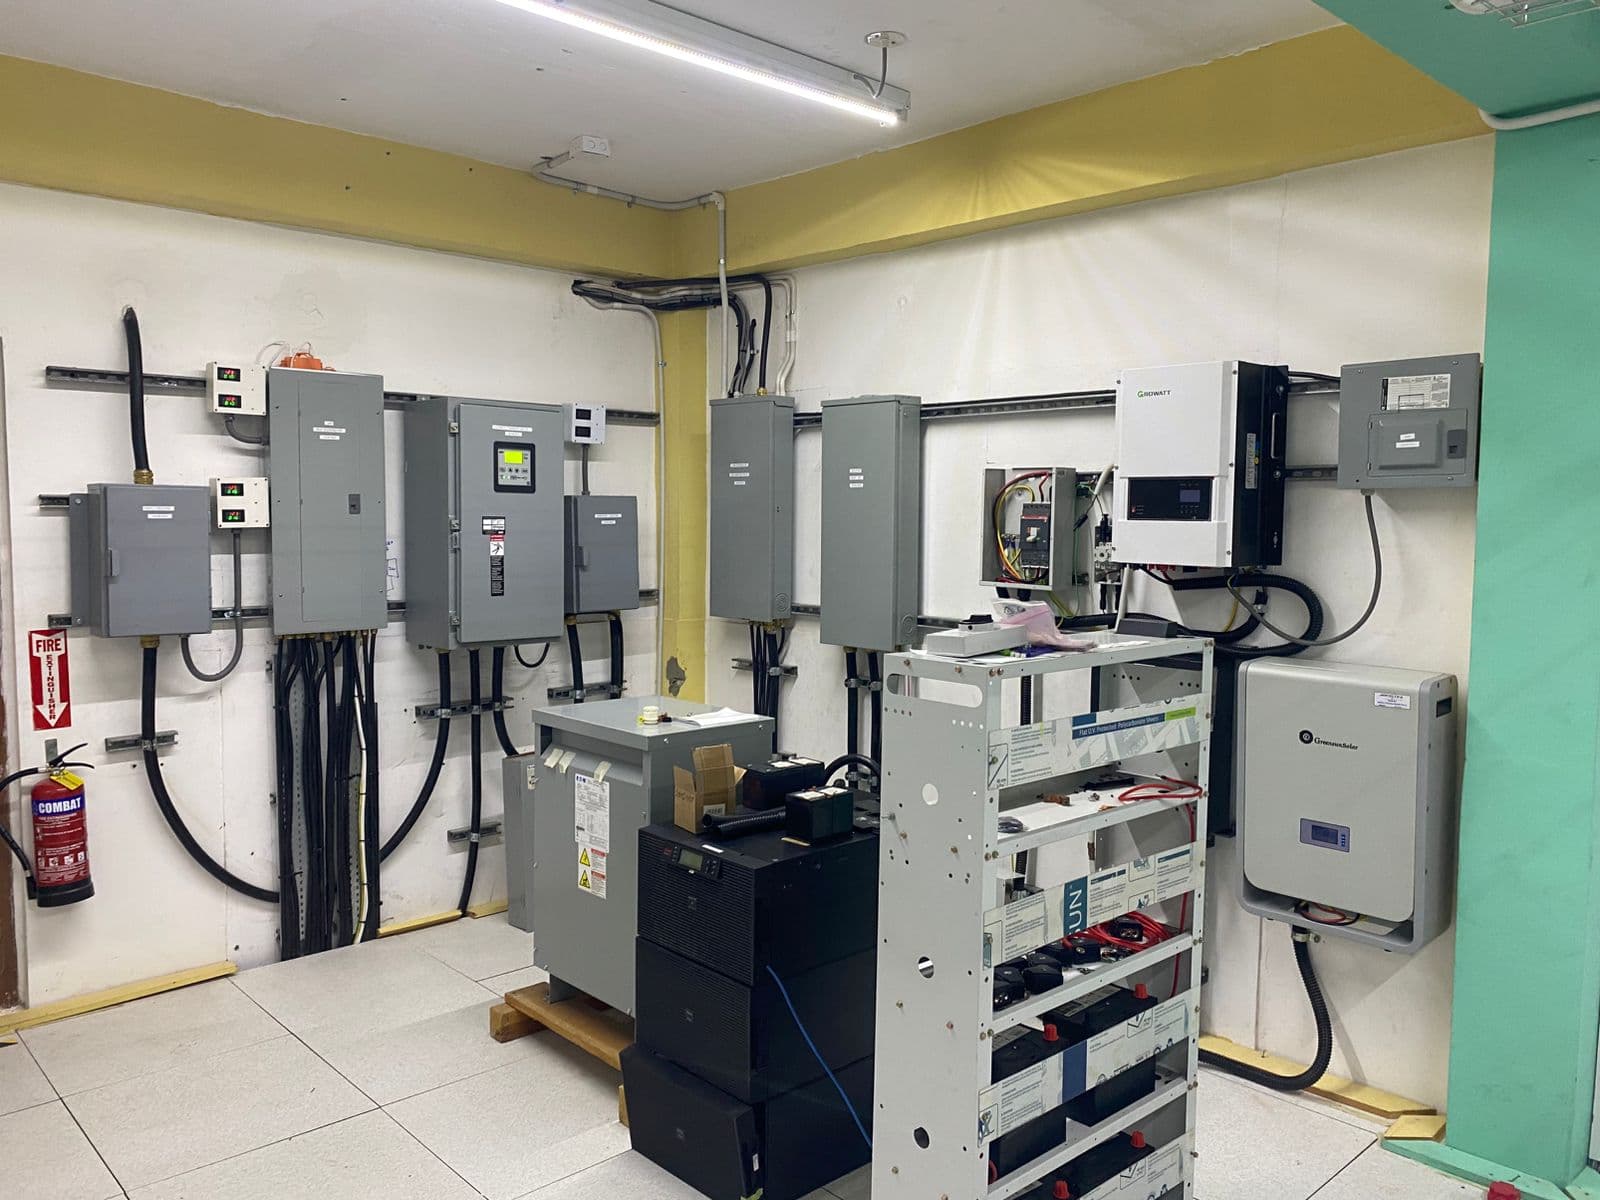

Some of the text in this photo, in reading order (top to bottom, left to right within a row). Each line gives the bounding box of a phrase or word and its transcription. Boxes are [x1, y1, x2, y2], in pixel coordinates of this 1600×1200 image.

[36, 638, 62, 653] FIRE
[46, 654, 56, 720] EXTINGUISHER
[38, 796, 82, 814] COMBAT
[1069, 889, 1082, 935] UN
